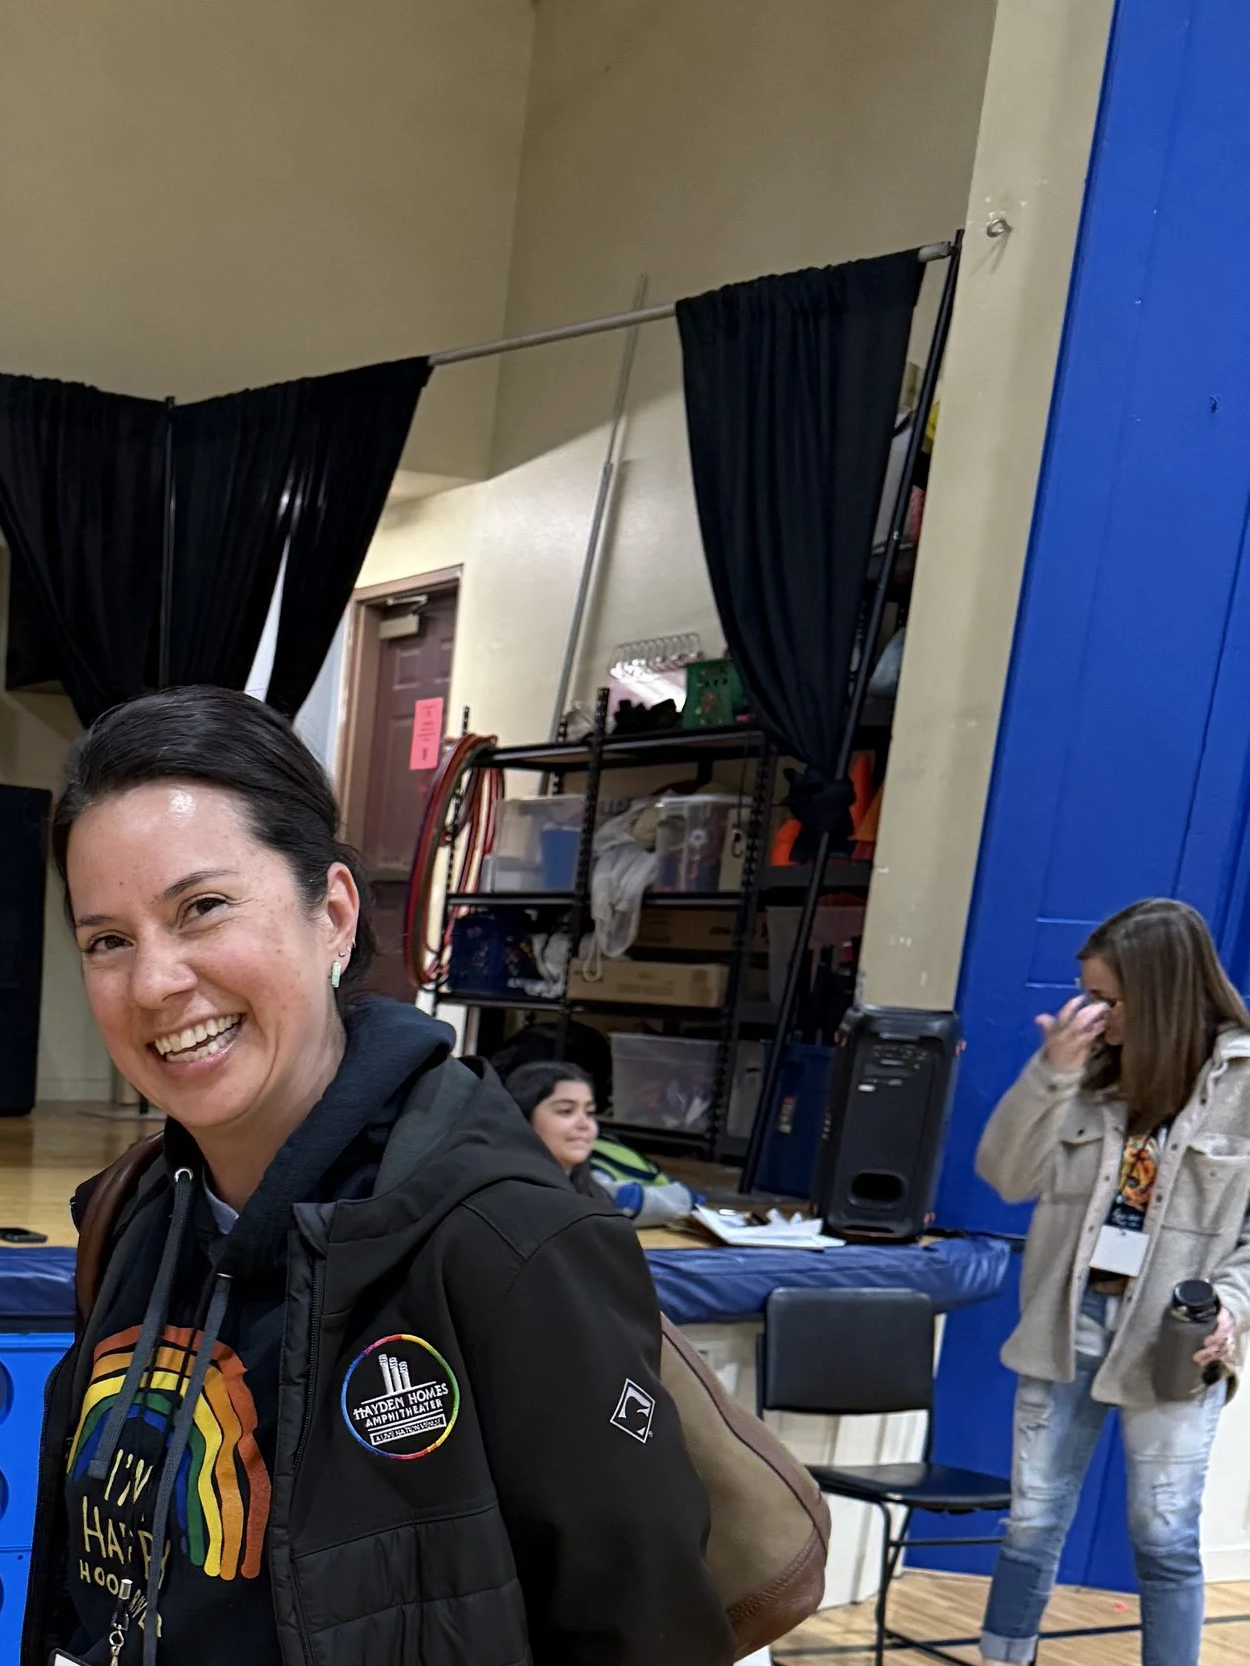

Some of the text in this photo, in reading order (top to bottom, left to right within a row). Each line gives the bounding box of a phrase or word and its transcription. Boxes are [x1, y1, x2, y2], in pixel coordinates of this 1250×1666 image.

[353, 1382, 449, 1420] HAYDEN HOMES
[365, 1398, 443, 1428] AMPHITHEATER
[79, 1558, 120, 1596] HOO
